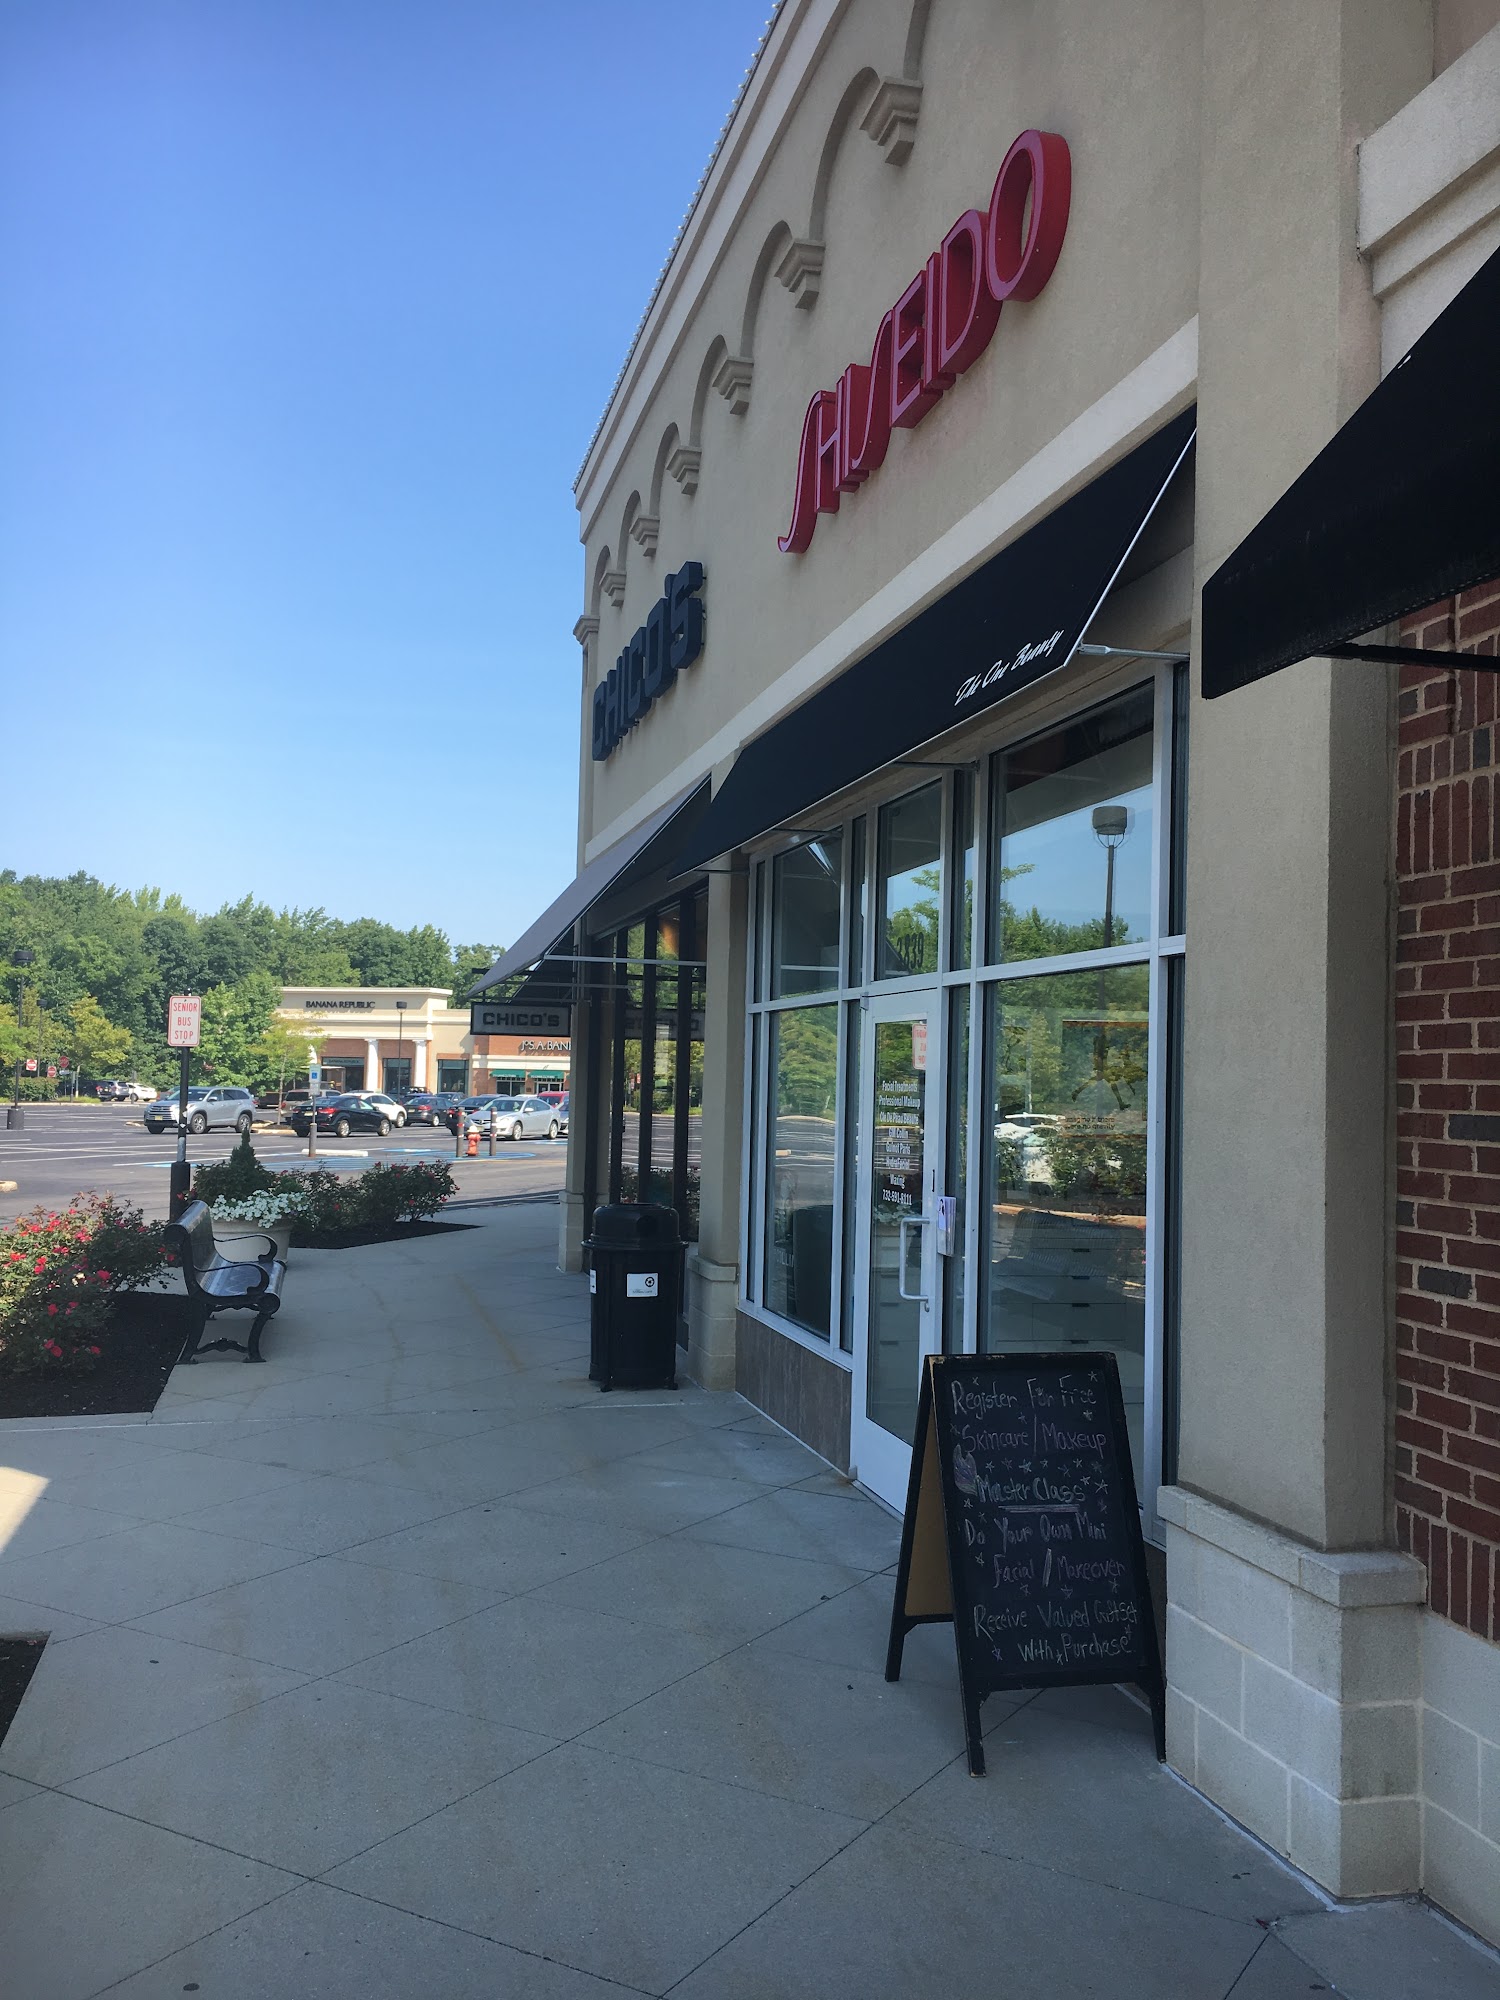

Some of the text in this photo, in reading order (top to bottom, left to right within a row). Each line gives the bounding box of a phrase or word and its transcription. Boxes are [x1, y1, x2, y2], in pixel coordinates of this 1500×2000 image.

[778, 129, 1071, 553] SHISEIDO
[592, 561, 703, 761] CHICO'S
[955, 630, 1064, 706] The One Beauty
[173, 1002, 198, 1012] SENIOR
[339, 1001, 375, 1009] REPUBLIC
[482, 1012, 560, 1027] CHICO'S
[174, 1030, 194, 1040] STOP
[177, 1017, 192, 1026] BUS
[879, 1095, 903, 1107] Professional
[951, 1374, 1097, 1420] Register For Free
[1032, 1477, 1086, 1503] Class
[965, 1511, 1107, 1553] Do Your Own Mini
[993, 1554, 1034, 1589] Facial
[1057, 1555, 1125, 1582] Makeover
[974, 1604, 1028, 1641] Receive
[1037, 1601, 1090, 1627] Valued
